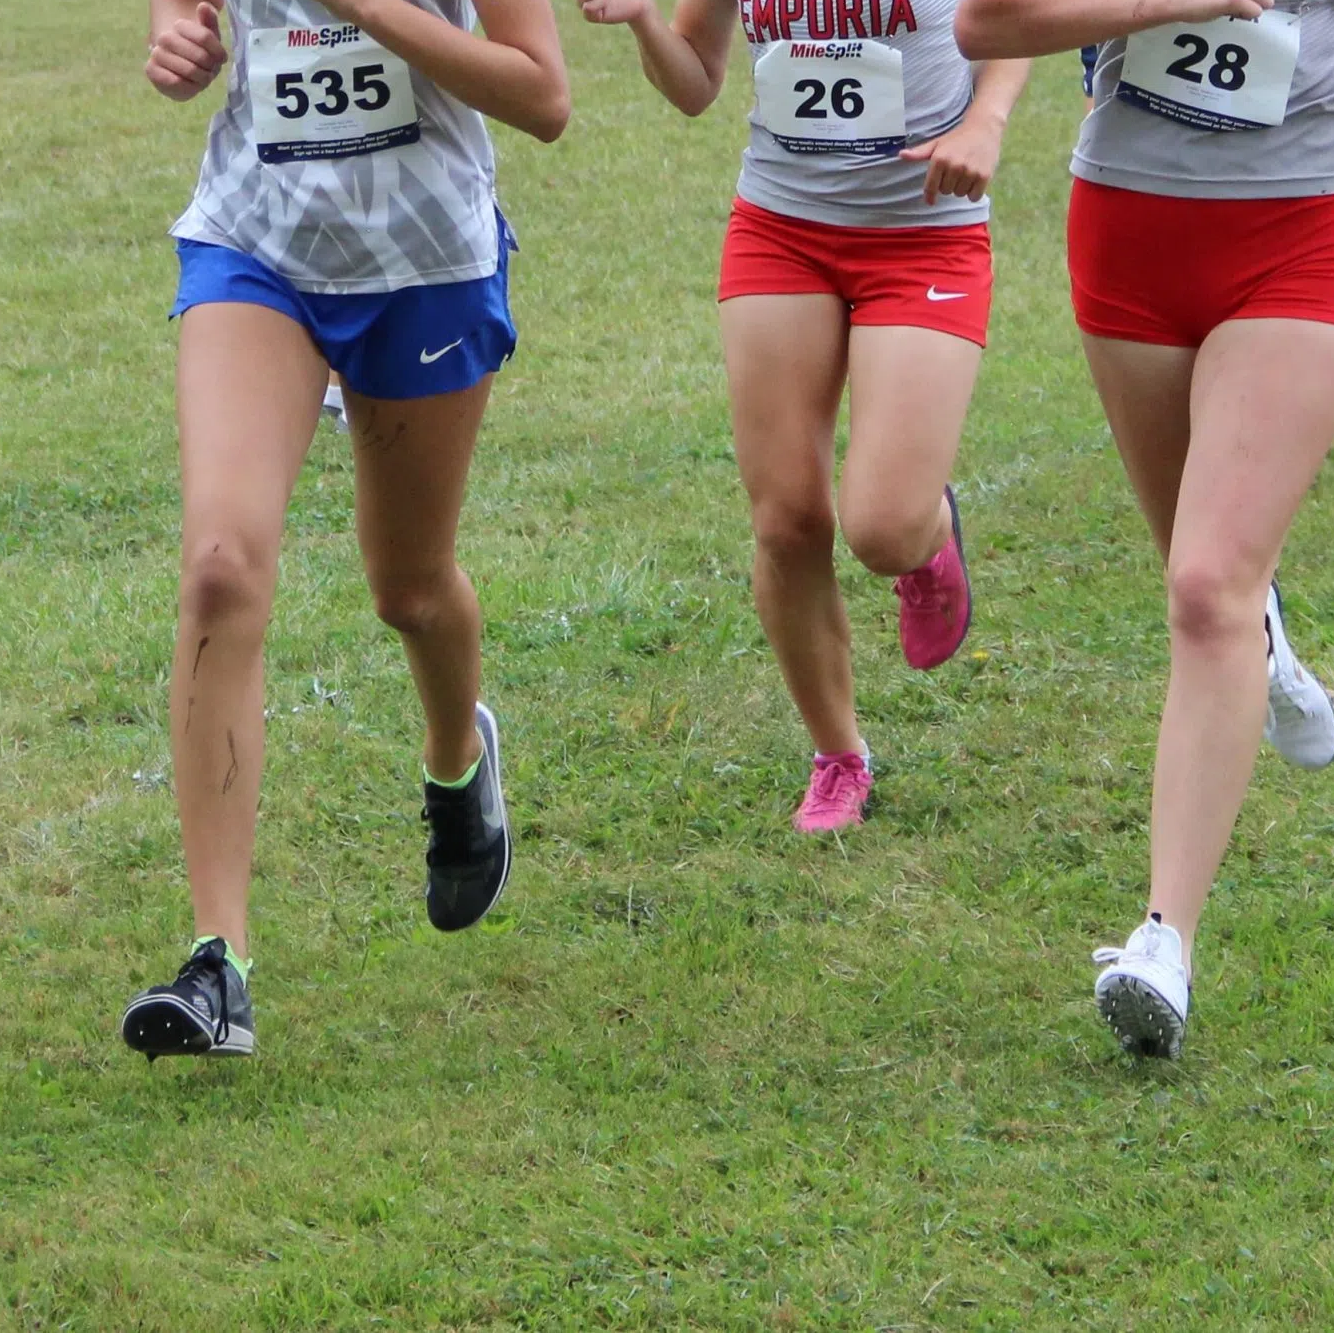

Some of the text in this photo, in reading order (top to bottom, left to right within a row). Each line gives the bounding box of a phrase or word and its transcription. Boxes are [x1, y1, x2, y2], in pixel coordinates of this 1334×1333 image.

[287, 25, 361, 48] MileSplit
[790, 42, 863, 61] MileSplit
[1165, 32, 1250, 91] 28
[275, 63, 391, 119] 535
[793, 78, 865, 119] 26
